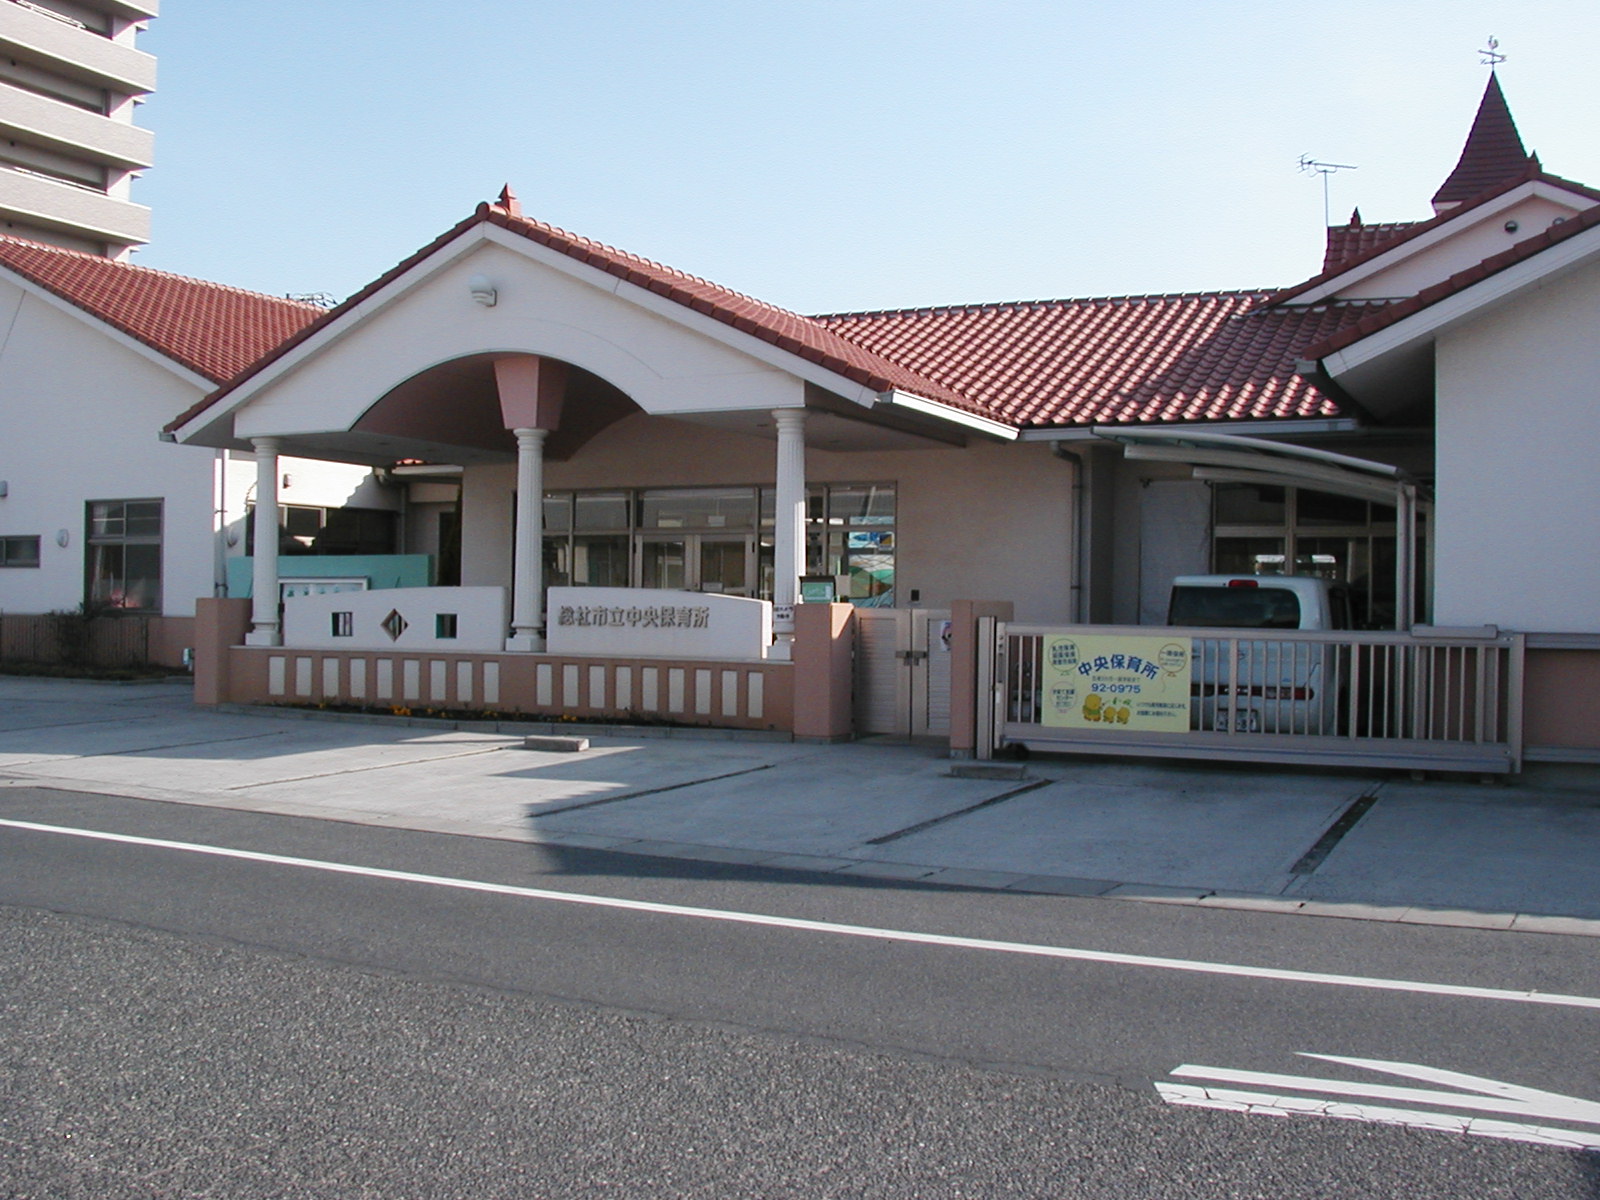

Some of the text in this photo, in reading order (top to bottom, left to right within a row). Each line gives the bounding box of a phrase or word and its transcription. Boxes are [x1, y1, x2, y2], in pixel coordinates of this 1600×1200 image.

[558, 605, 710, 628] 総社市立中央保育所
[1078, 653, 1160, 680] 中央保育所
[1091, 683, 1141, 694] 92-0975
